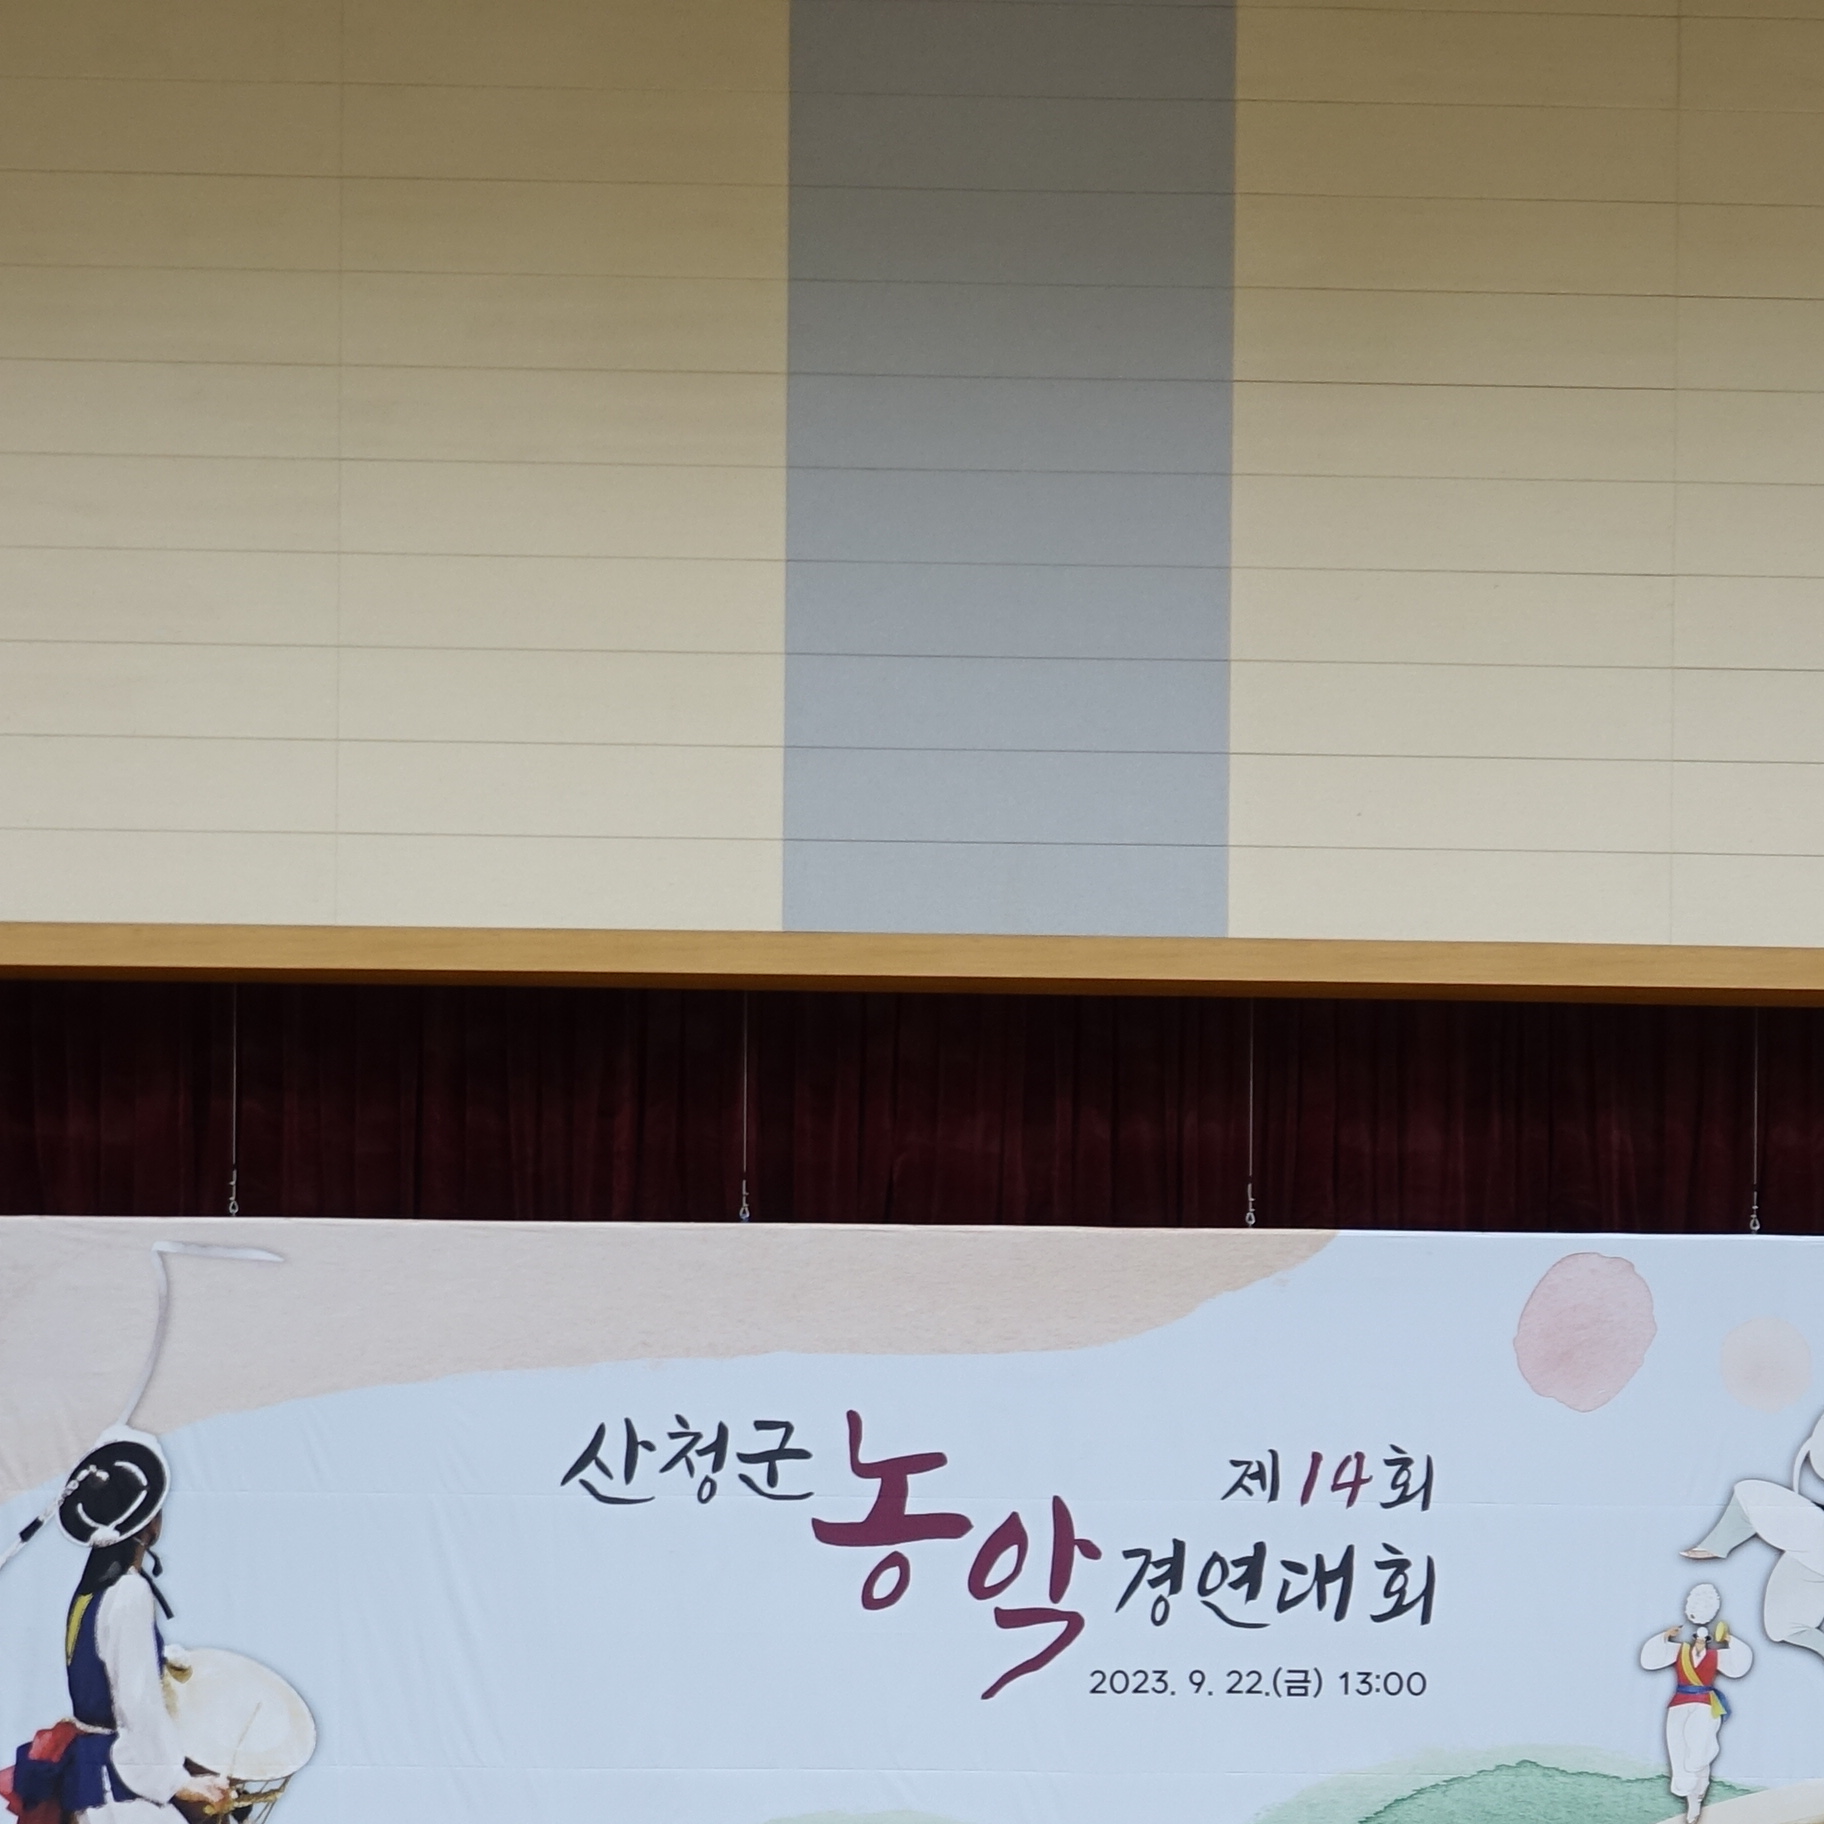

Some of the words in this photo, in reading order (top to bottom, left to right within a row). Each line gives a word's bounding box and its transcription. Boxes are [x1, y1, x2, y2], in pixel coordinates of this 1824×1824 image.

[1221, 1448, 1436, 1511] 제14회
[560, 1415, 814, 1505] 산청군
[811, 1409, 1103, 1700] 농악
[1115, 1538, 1437, 1628] 경연대회
[1089, 1669, 1176, 1697] 2023.
[1188, 1669, 1214, 1697] 9.
[1338, 1671, 1428, 1697] 13:00
